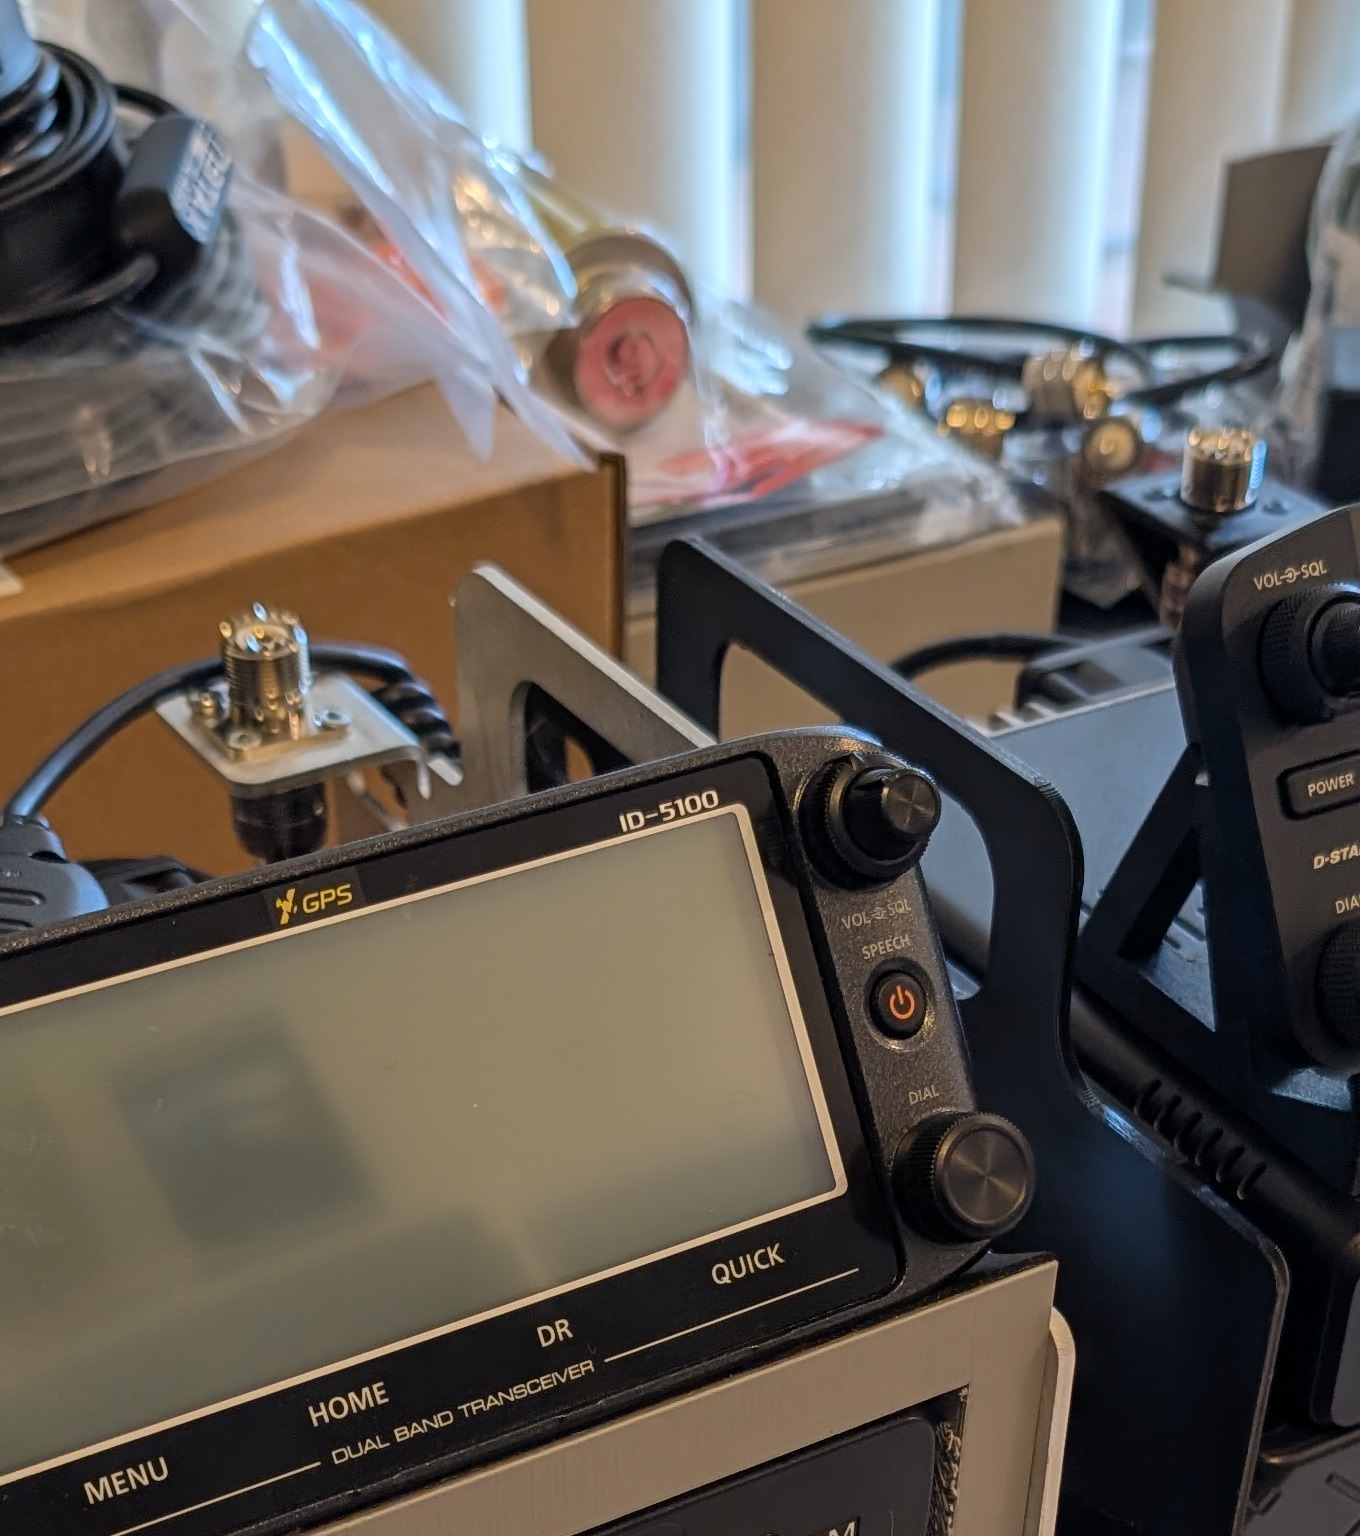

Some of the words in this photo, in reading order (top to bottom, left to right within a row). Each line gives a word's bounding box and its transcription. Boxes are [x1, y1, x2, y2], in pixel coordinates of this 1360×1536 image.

[1307, 772, 1355, 797] POWER
[619, 789, 719, 832] ID-5100
[302, 883, 353, 914] GPS
[861, 934, 911, 960] SPEECH
[908, 1084, 940, 1106] DIAL
[711, 1242, 786, 1286] QUICK
[537, 1317, 574, 1349] DR
[308, 1381, 390, 1428] HOME
[331, 1435, 392, 1466] DUAL
[393, 1410, 455, 1443] BAND
[457, 1358, 596, 1419] TRANSCEIVER
[83, 1456, 170, 1505] MENU
